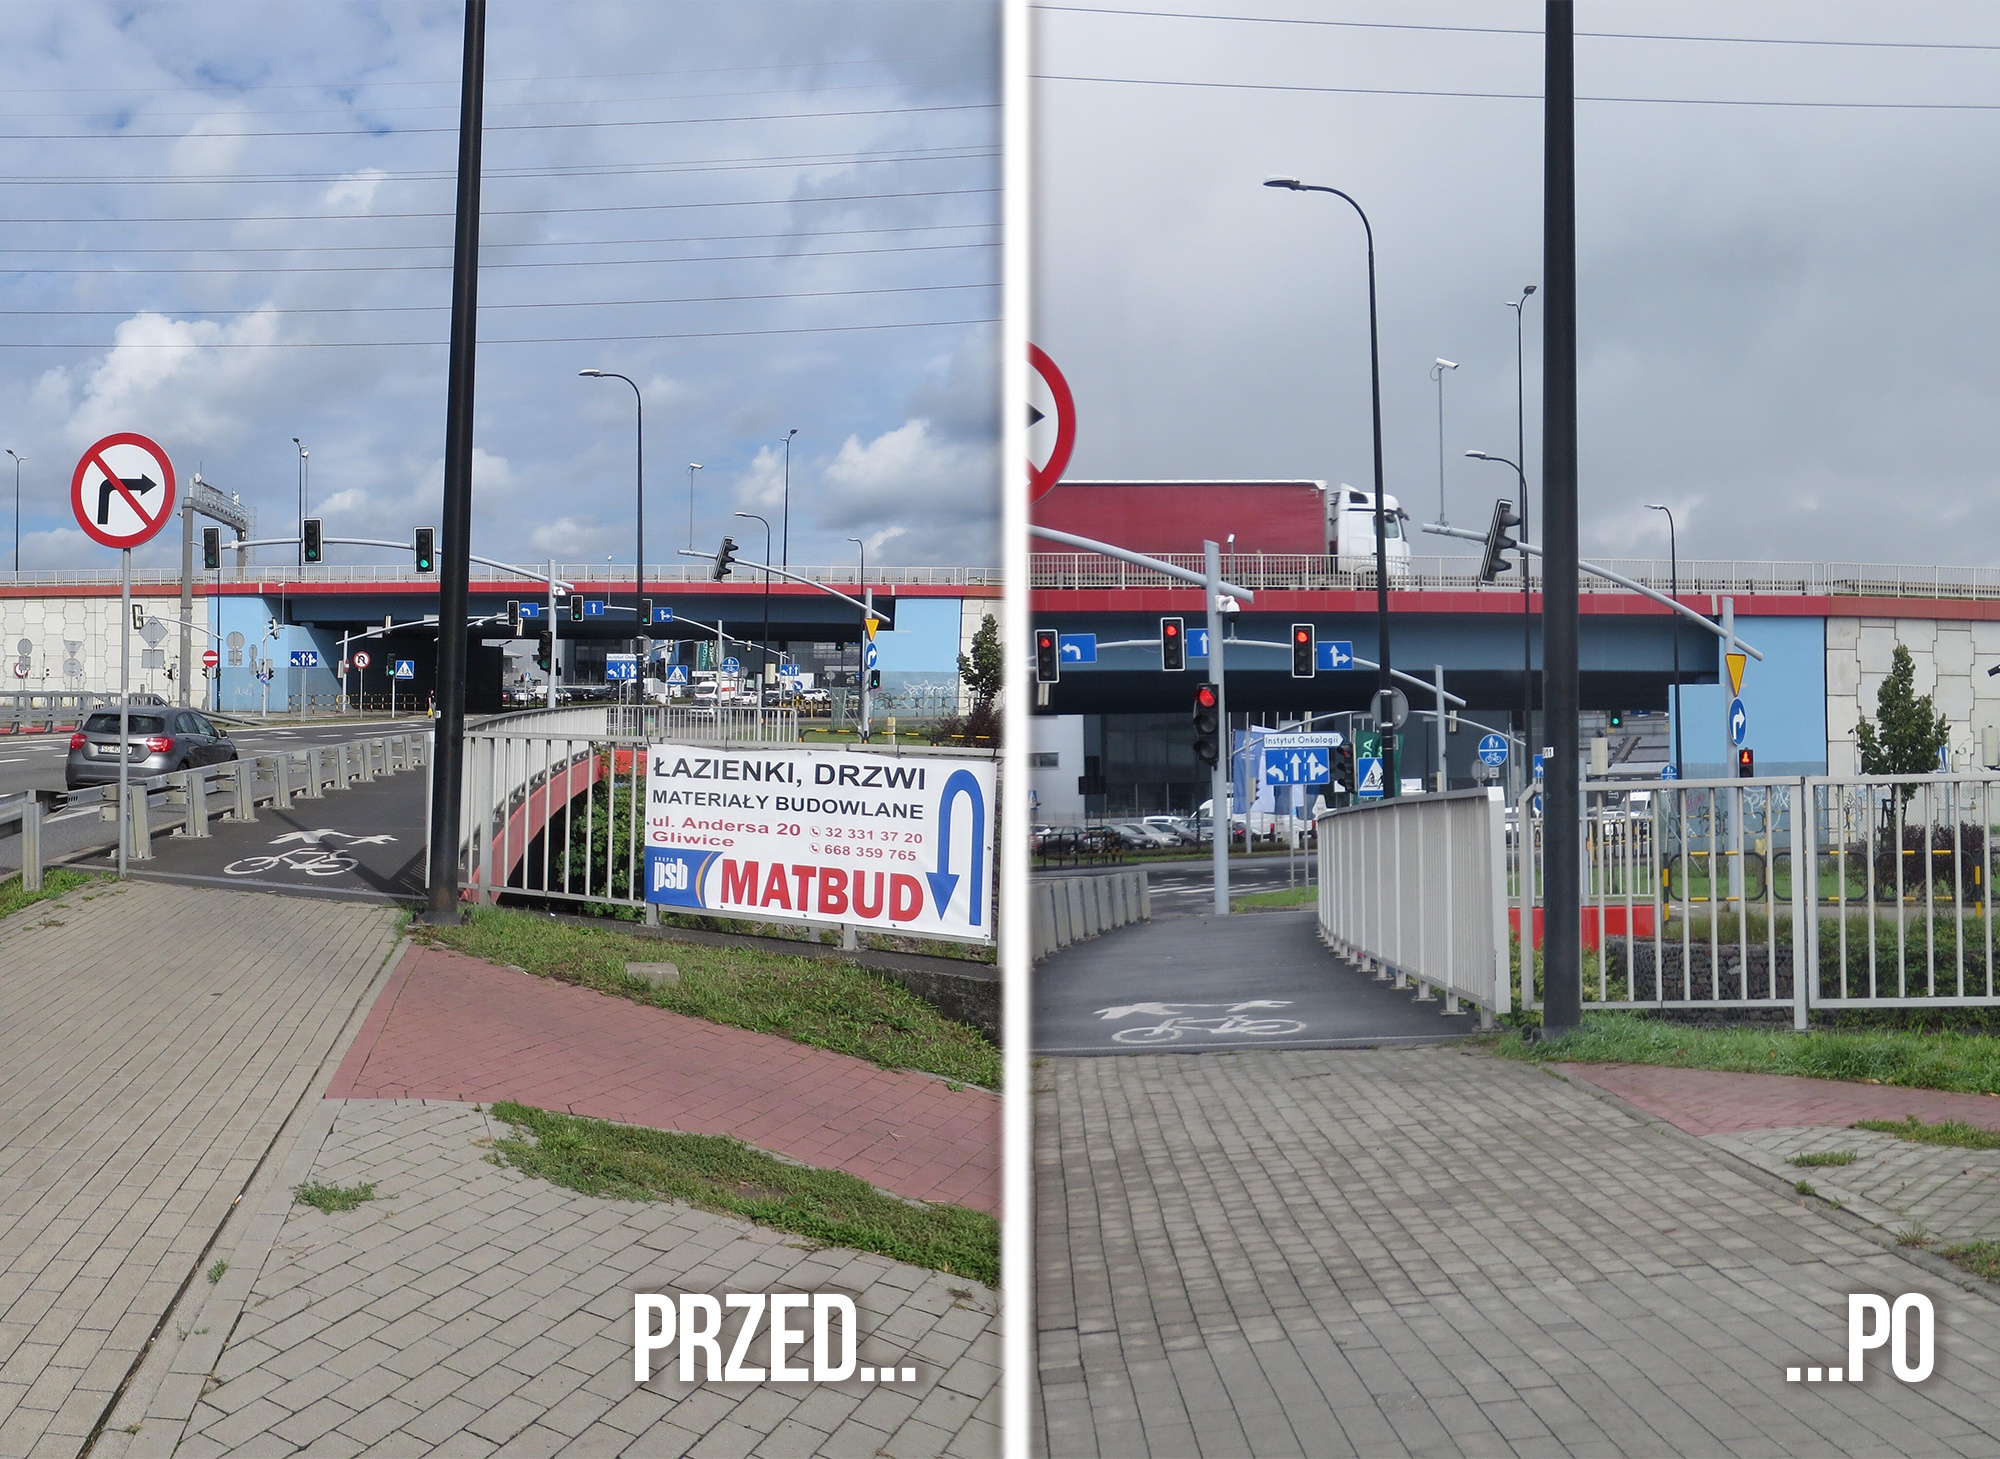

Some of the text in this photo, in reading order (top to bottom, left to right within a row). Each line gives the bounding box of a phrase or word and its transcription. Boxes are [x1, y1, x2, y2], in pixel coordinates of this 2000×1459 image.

[1266, 735, 1339, 746] Instytut Onkologii
[653, 757, 926, 790] ŁAZIENKI, DRZWI
[652, 790, 924, 820] MATERIAŁY BUDOWLANE
[652, 816, 801, 837] ul. Andersa 20
[825, 827, 923, 844] 32 331 37 20
[652, 831, 735, 847] Gliwice
[824, 844, 917, 861] 668 359 765
[653, 858, 688, 892] psb
[720, 859, 925, 922] MATBUD
